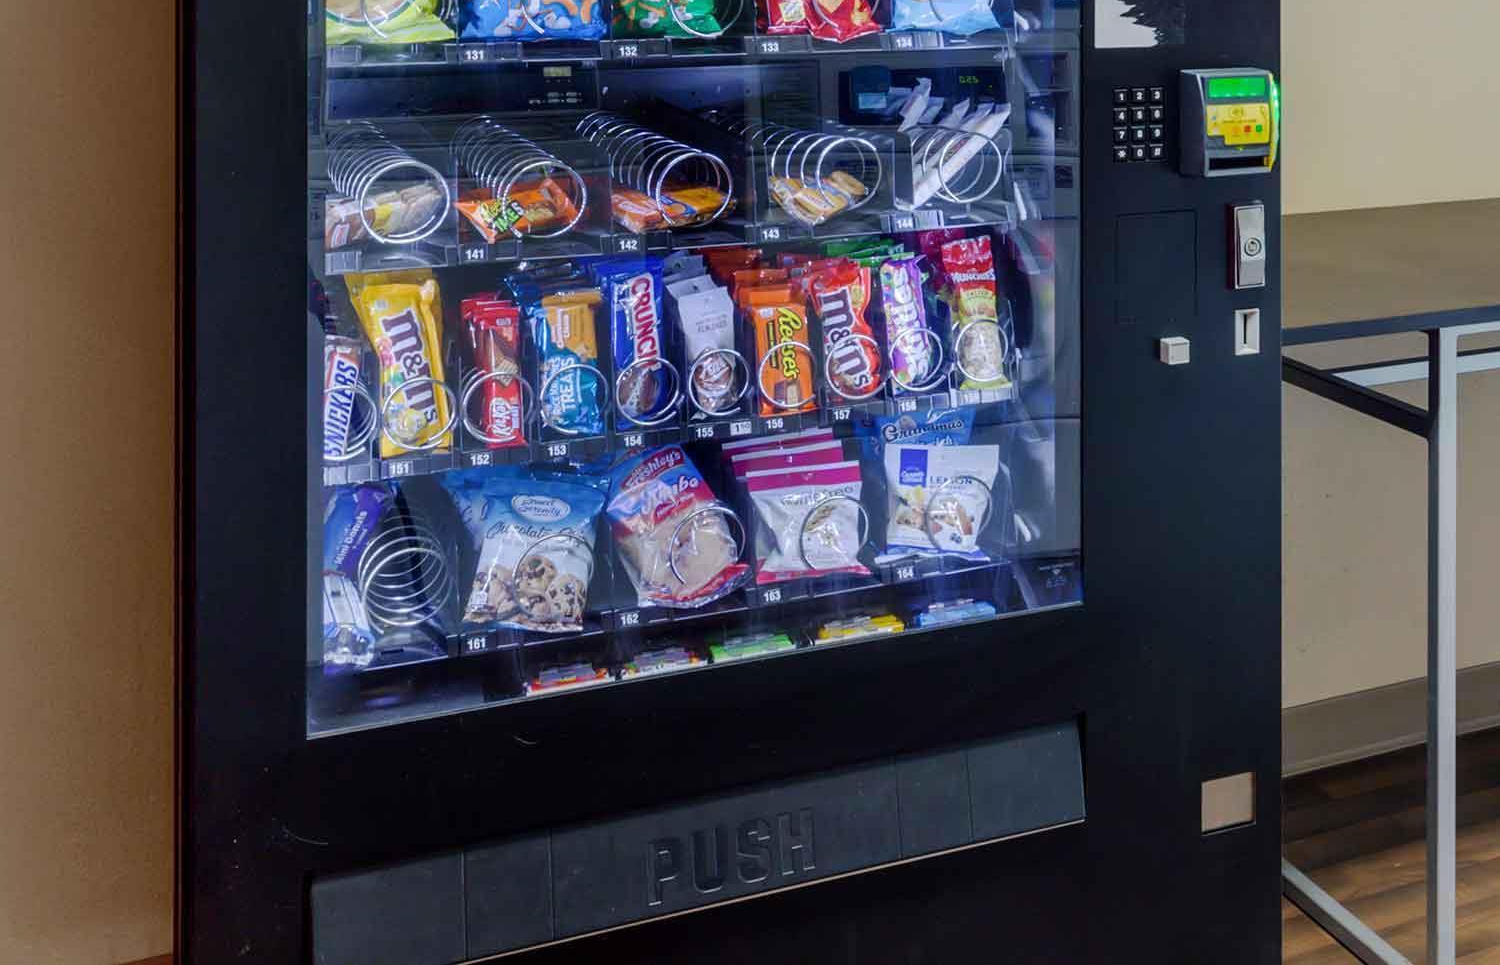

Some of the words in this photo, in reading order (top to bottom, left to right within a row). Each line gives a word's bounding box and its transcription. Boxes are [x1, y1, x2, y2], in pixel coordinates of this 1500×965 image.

[618, 47, 638, 57] 132
[761, 42, 780, 52] 133
[465, 50, 485, 60] 131
[762, 228, 780, 240] 143
[618, 239, 638, 250] 142
[465, 248, 485, 260] 141
[629, 275, 663, 371] CRUNCH
[323, 358, 359, 457] SNICKERS
[833, 409, 851, 420] 157
[766, 419, 784, 429] 156
[695, 427, 714, 438] 155
[624, 436, 642, 447] 154
[547, 445, 567, 457] 153
[470, 454, 490, 466] 152
[389, 462, 410, 474] 151
[762, 588, 782, 603] 163
[620, 613, 640, 625] 162
[466, 638, 487, 650] 161
[648, 806, 817, 906] PUSH
